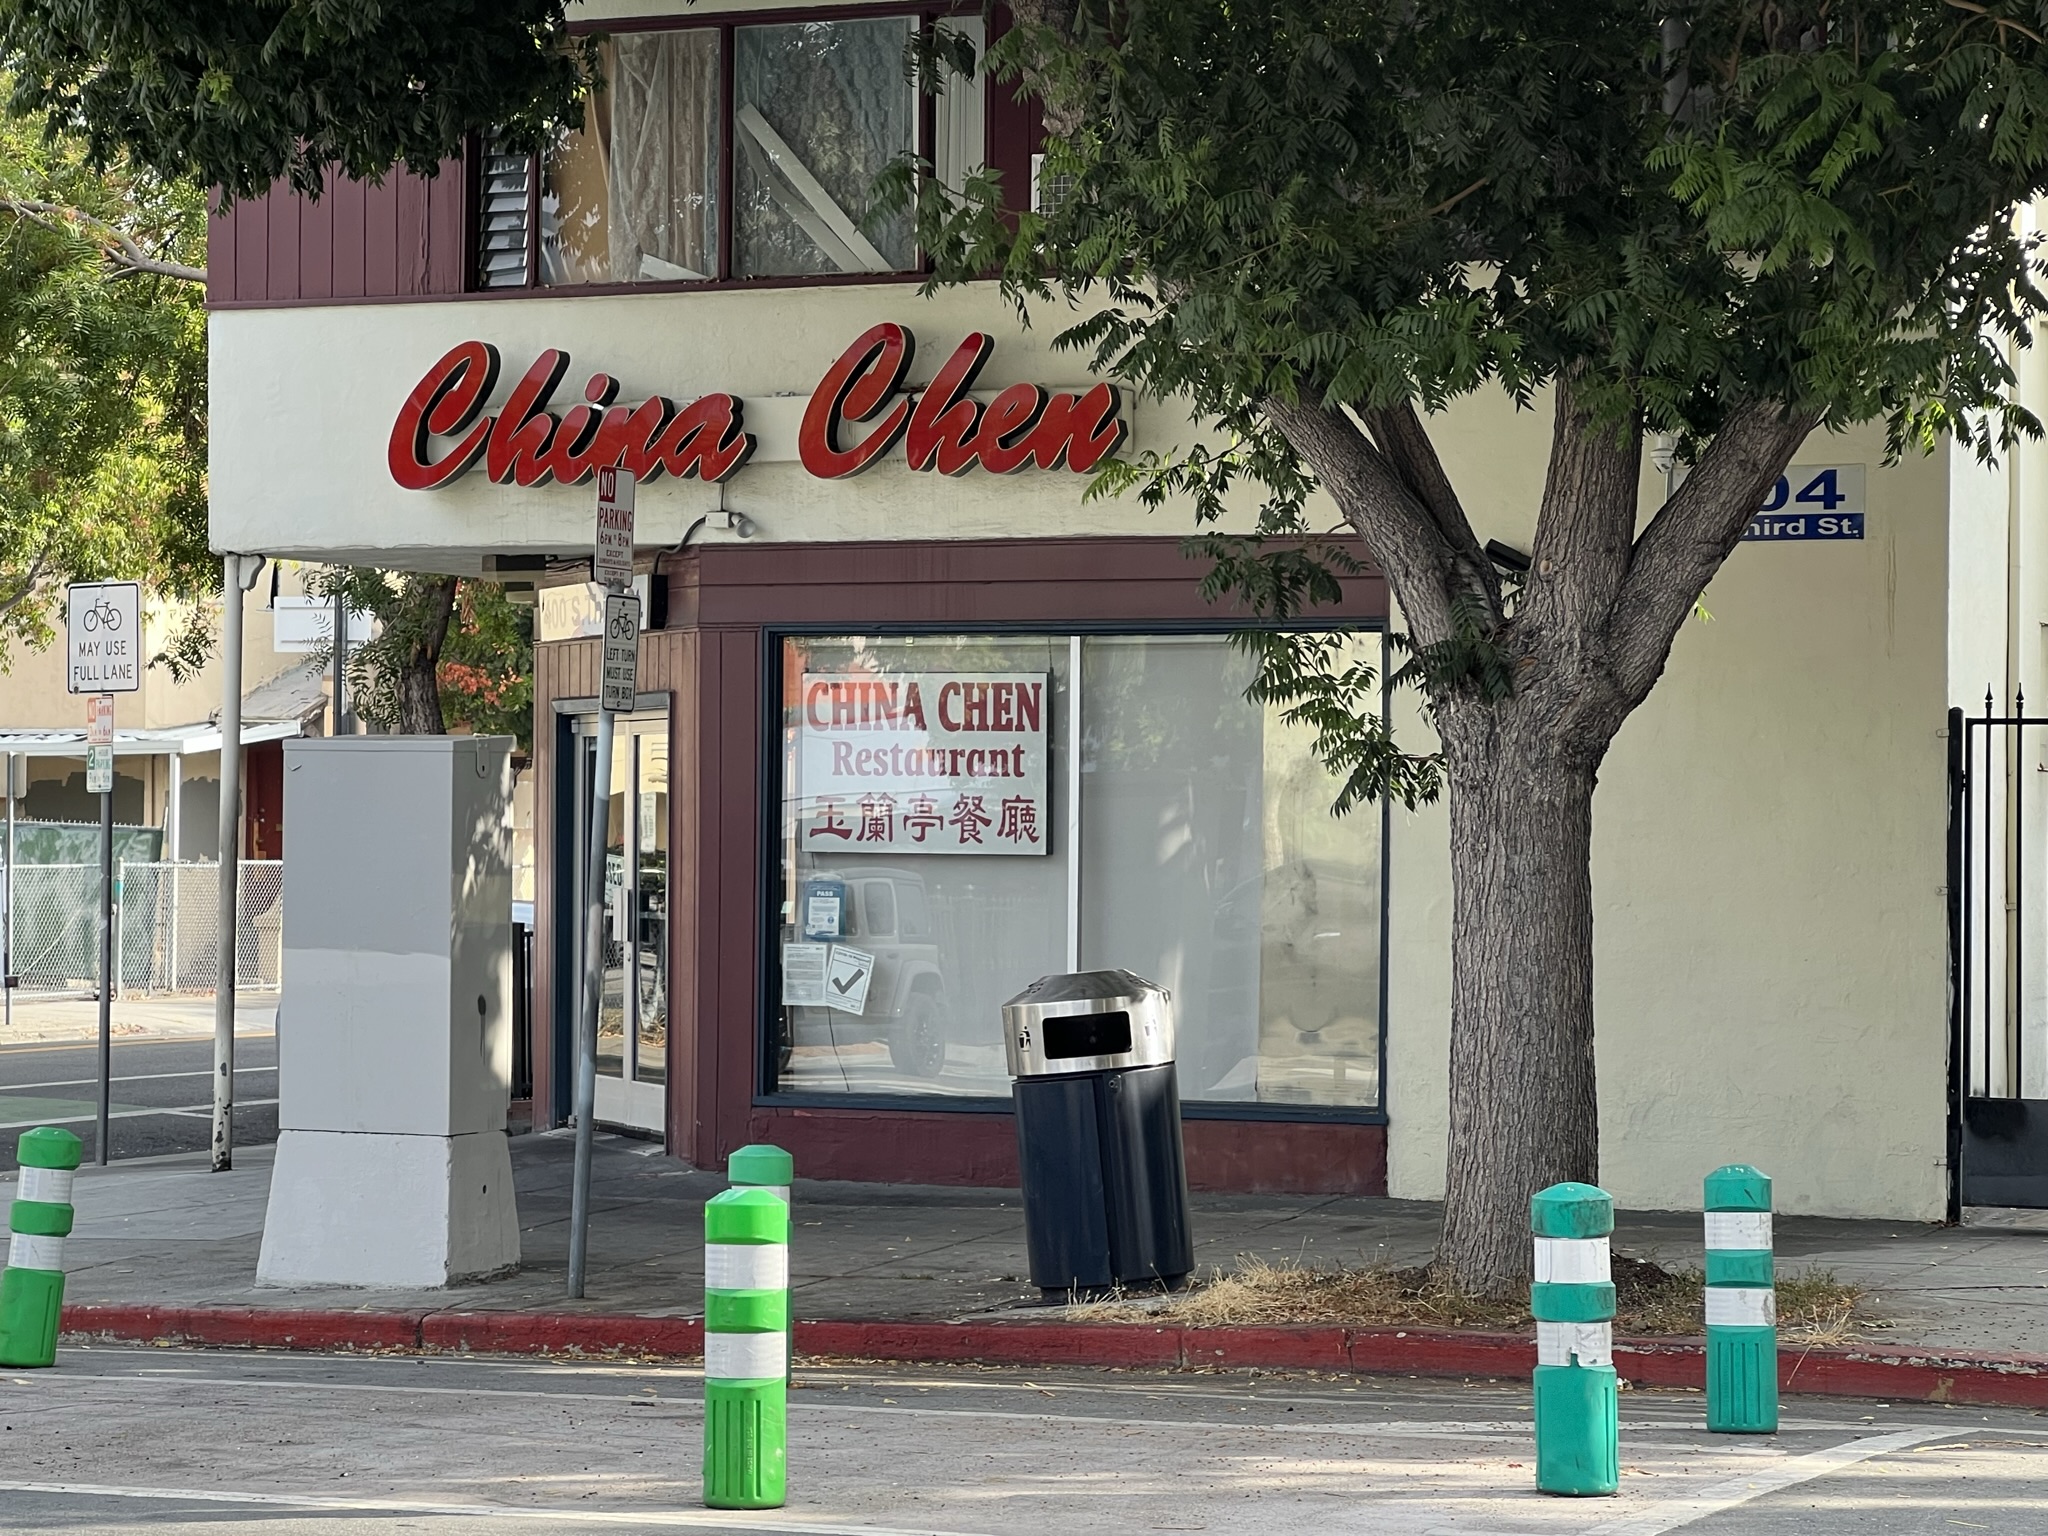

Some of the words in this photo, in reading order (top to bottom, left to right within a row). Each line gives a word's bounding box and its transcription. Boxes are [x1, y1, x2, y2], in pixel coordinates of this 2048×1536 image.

[388, 340, 757, 490] China
[798, 322, 1129, 479] Chen
[601, 471, 615, 498] NO
[599, 507, 632, 532] PARKING
[1744, 518, 1805, 536] hird
[1817, 517, 1859, 535] St.
[606, 549, 624, 558] EXCEPT
[78, 642, 102, 657] MAY
[105, 640, 127, 656] USE
[607, 648, 620, 661] LEFT
[622, 649, 635, 662] TURN
[73, 665, 99, 681] FULL
[103, 664, 133, 680] LANE
[606, 666, 621, 680] MUST
[622, 668, 633, 681] USE
[605, 685, 621, 699] TURN
[621, 686, 632, 699] BOX
[806, 681, 928, 732] CHINA
[938, 681, 1043, 732] CHEN
[88, 749, 95, 767] 2
[832, 741, 1025, 778] Restaurant
